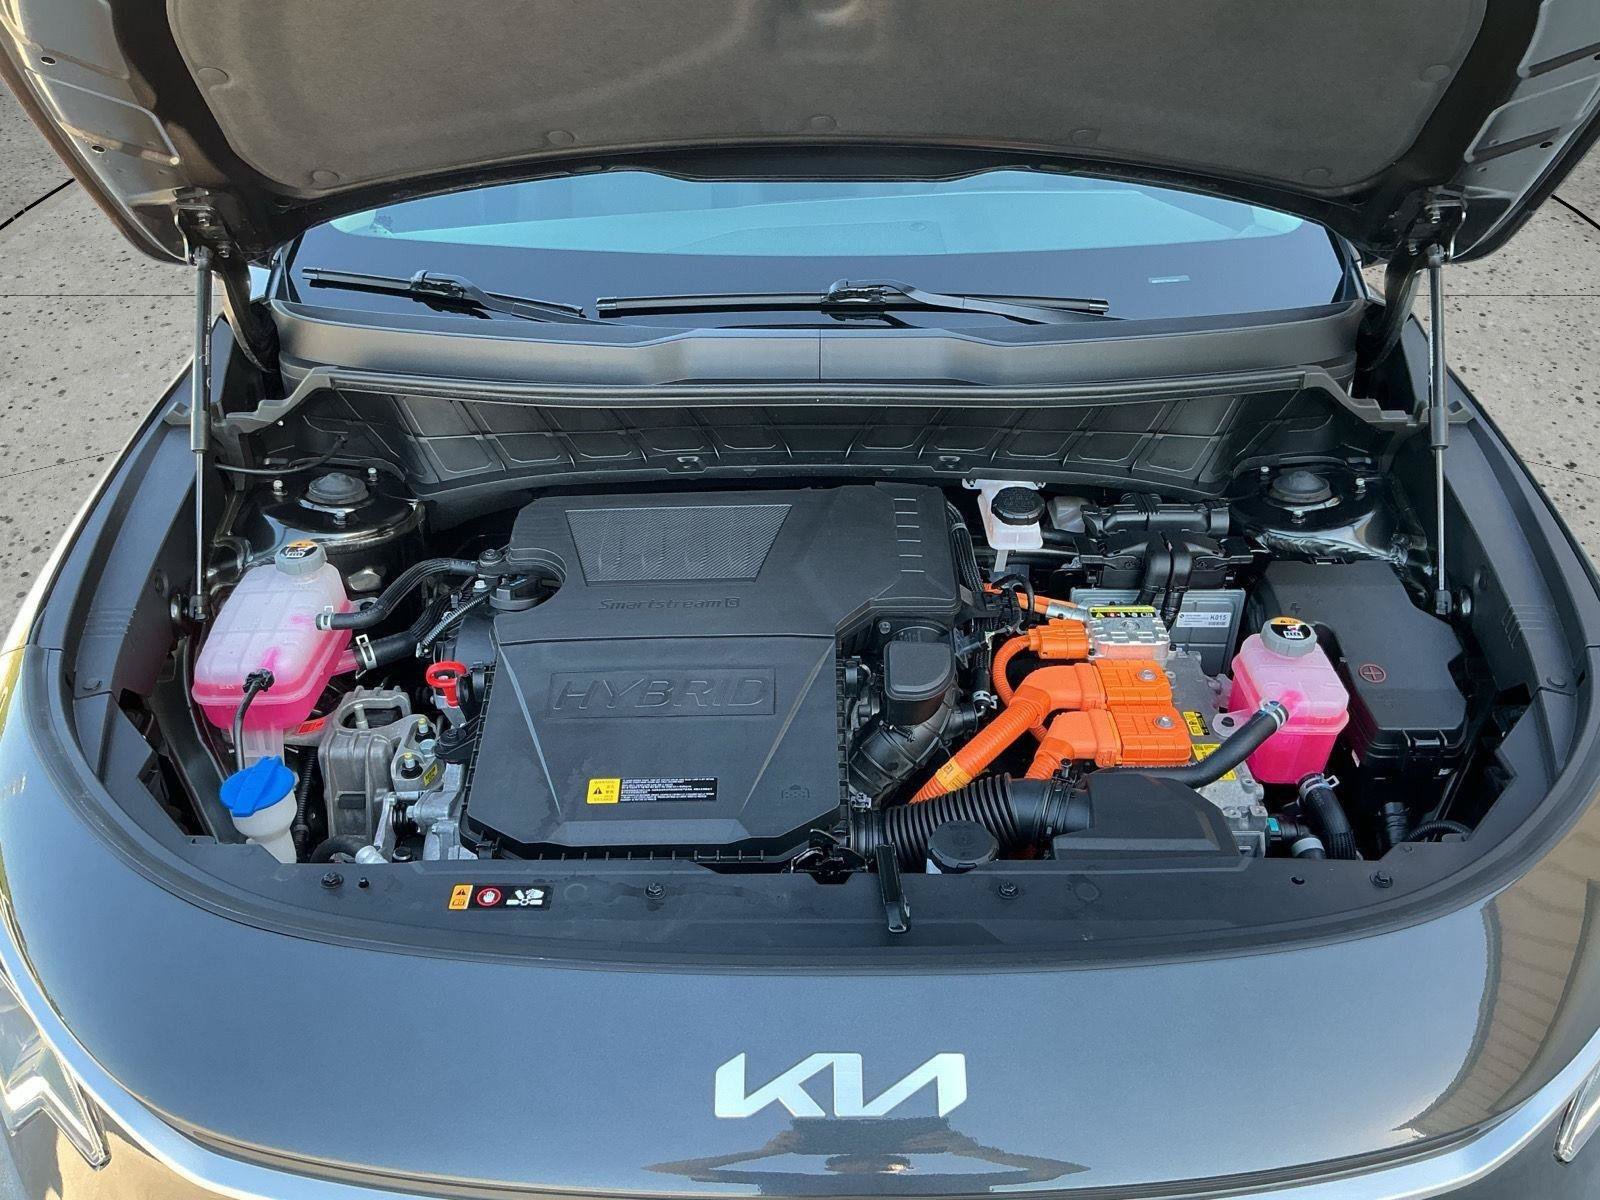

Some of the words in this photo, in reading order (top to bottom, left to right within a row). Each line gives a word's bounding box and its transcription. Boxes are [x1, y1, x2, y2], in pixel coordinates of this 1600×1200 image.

[598, 597, 721, 610] Smartstream
[552, 678, 766, 710] HYBRID
[714, 1052, 968, 1119] KIA
